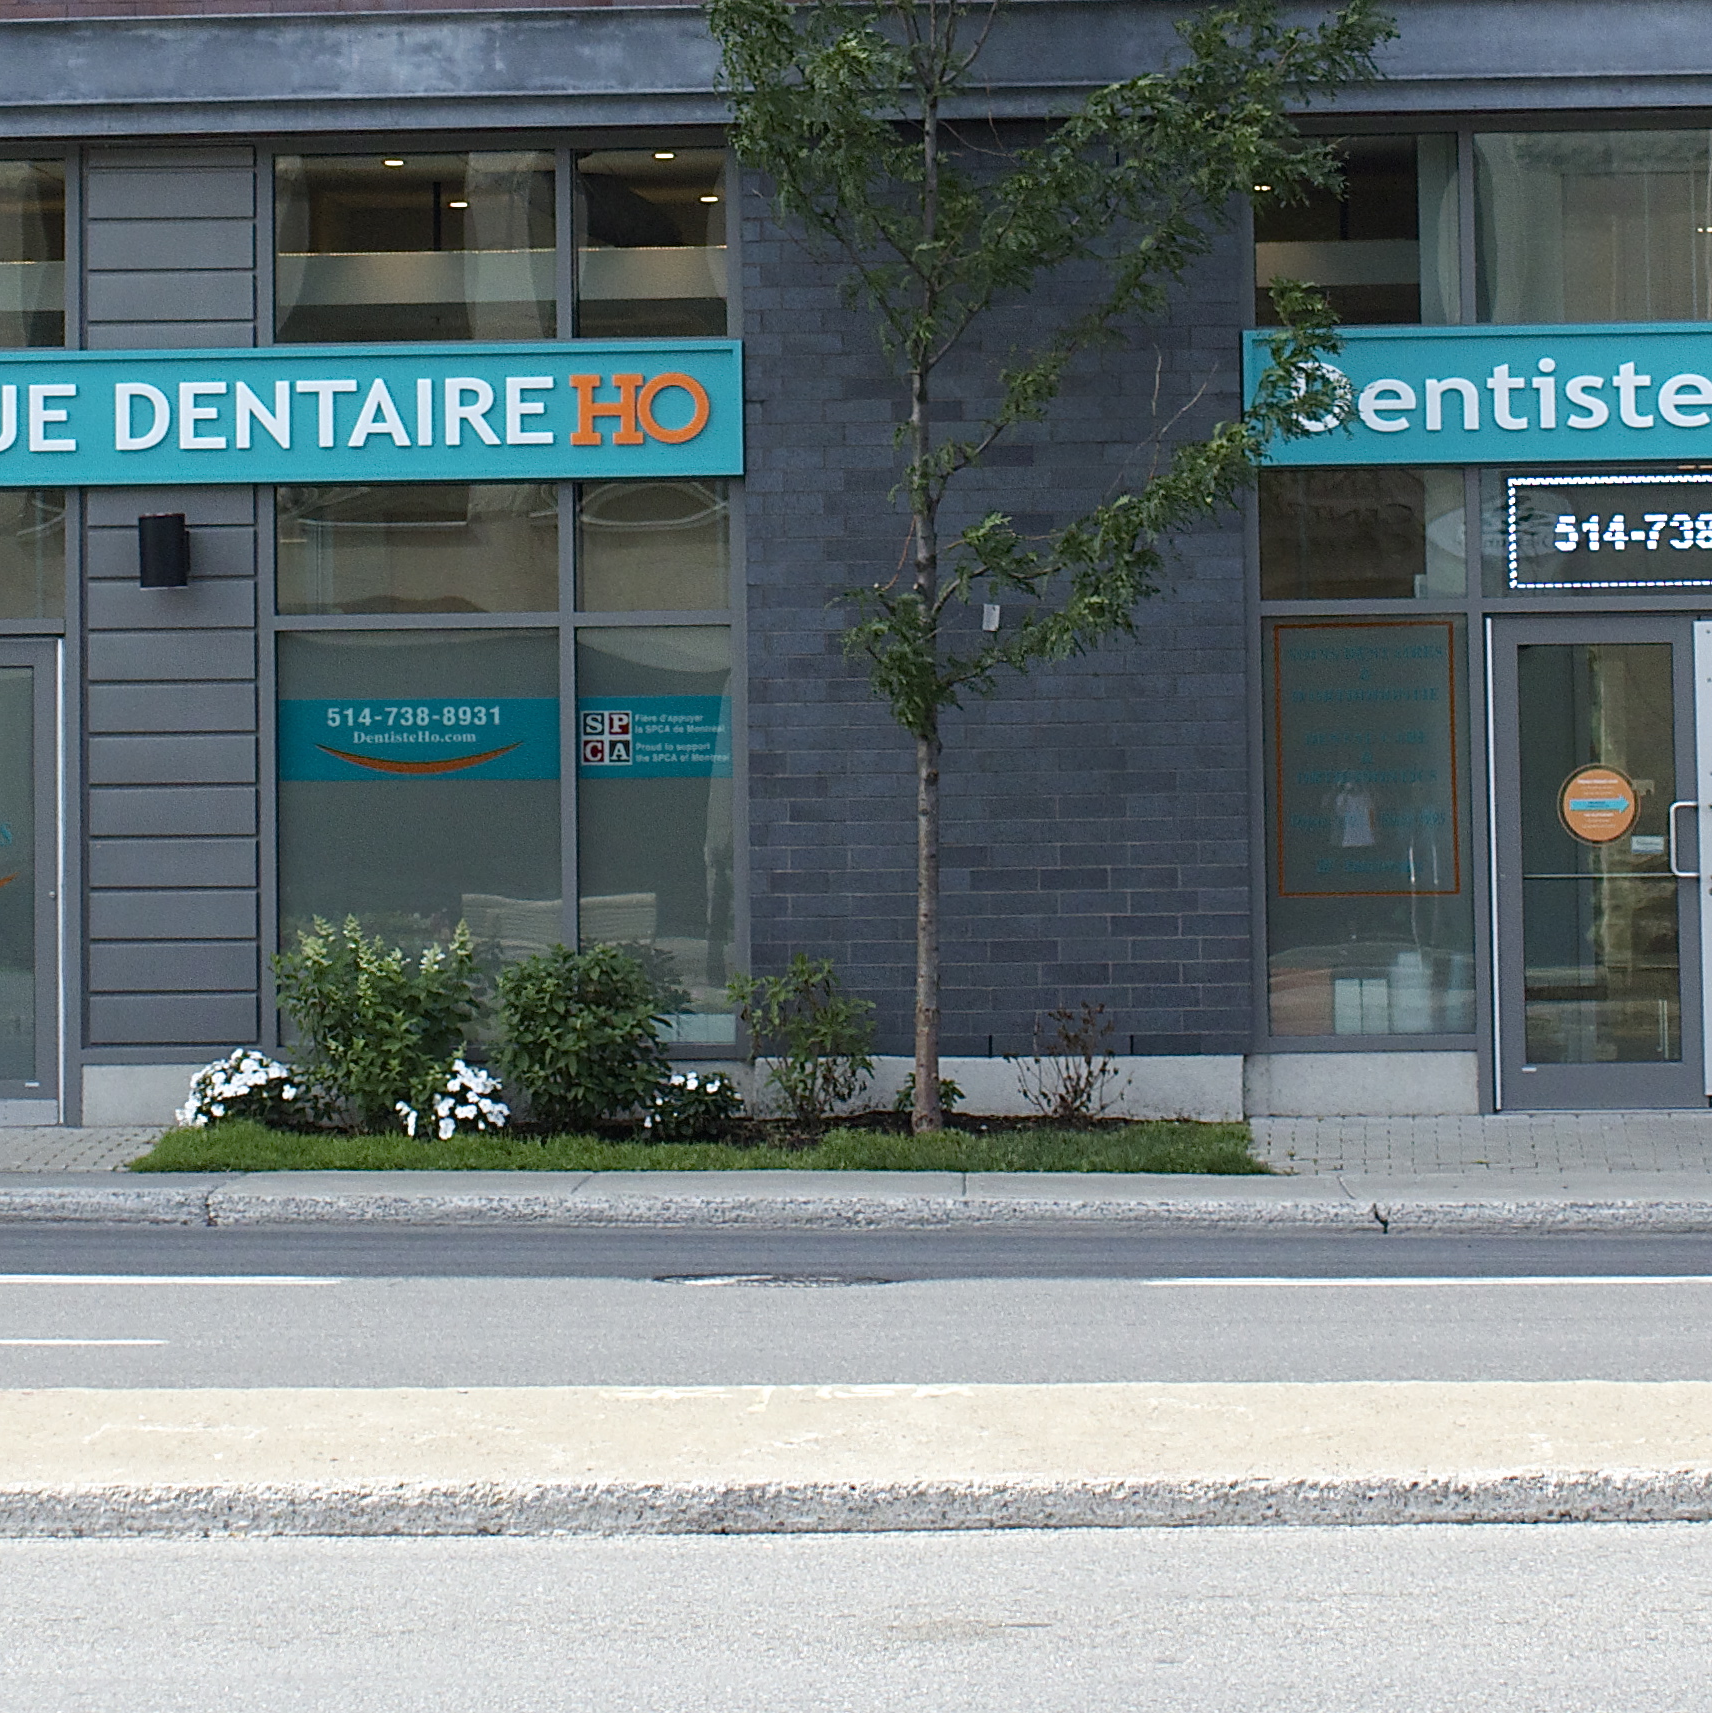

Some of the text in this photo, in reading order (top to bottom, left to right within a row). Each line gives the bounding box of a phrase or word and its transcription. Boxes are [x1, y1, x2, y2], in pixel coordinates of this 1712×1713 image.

[114, 377, 554, 451] DENTAIRE
[569, 372, 710, 446] HO
[327, 706, 501, 727] 514-738-8931
[353, 731, 477, 744] DentisteHo.com
